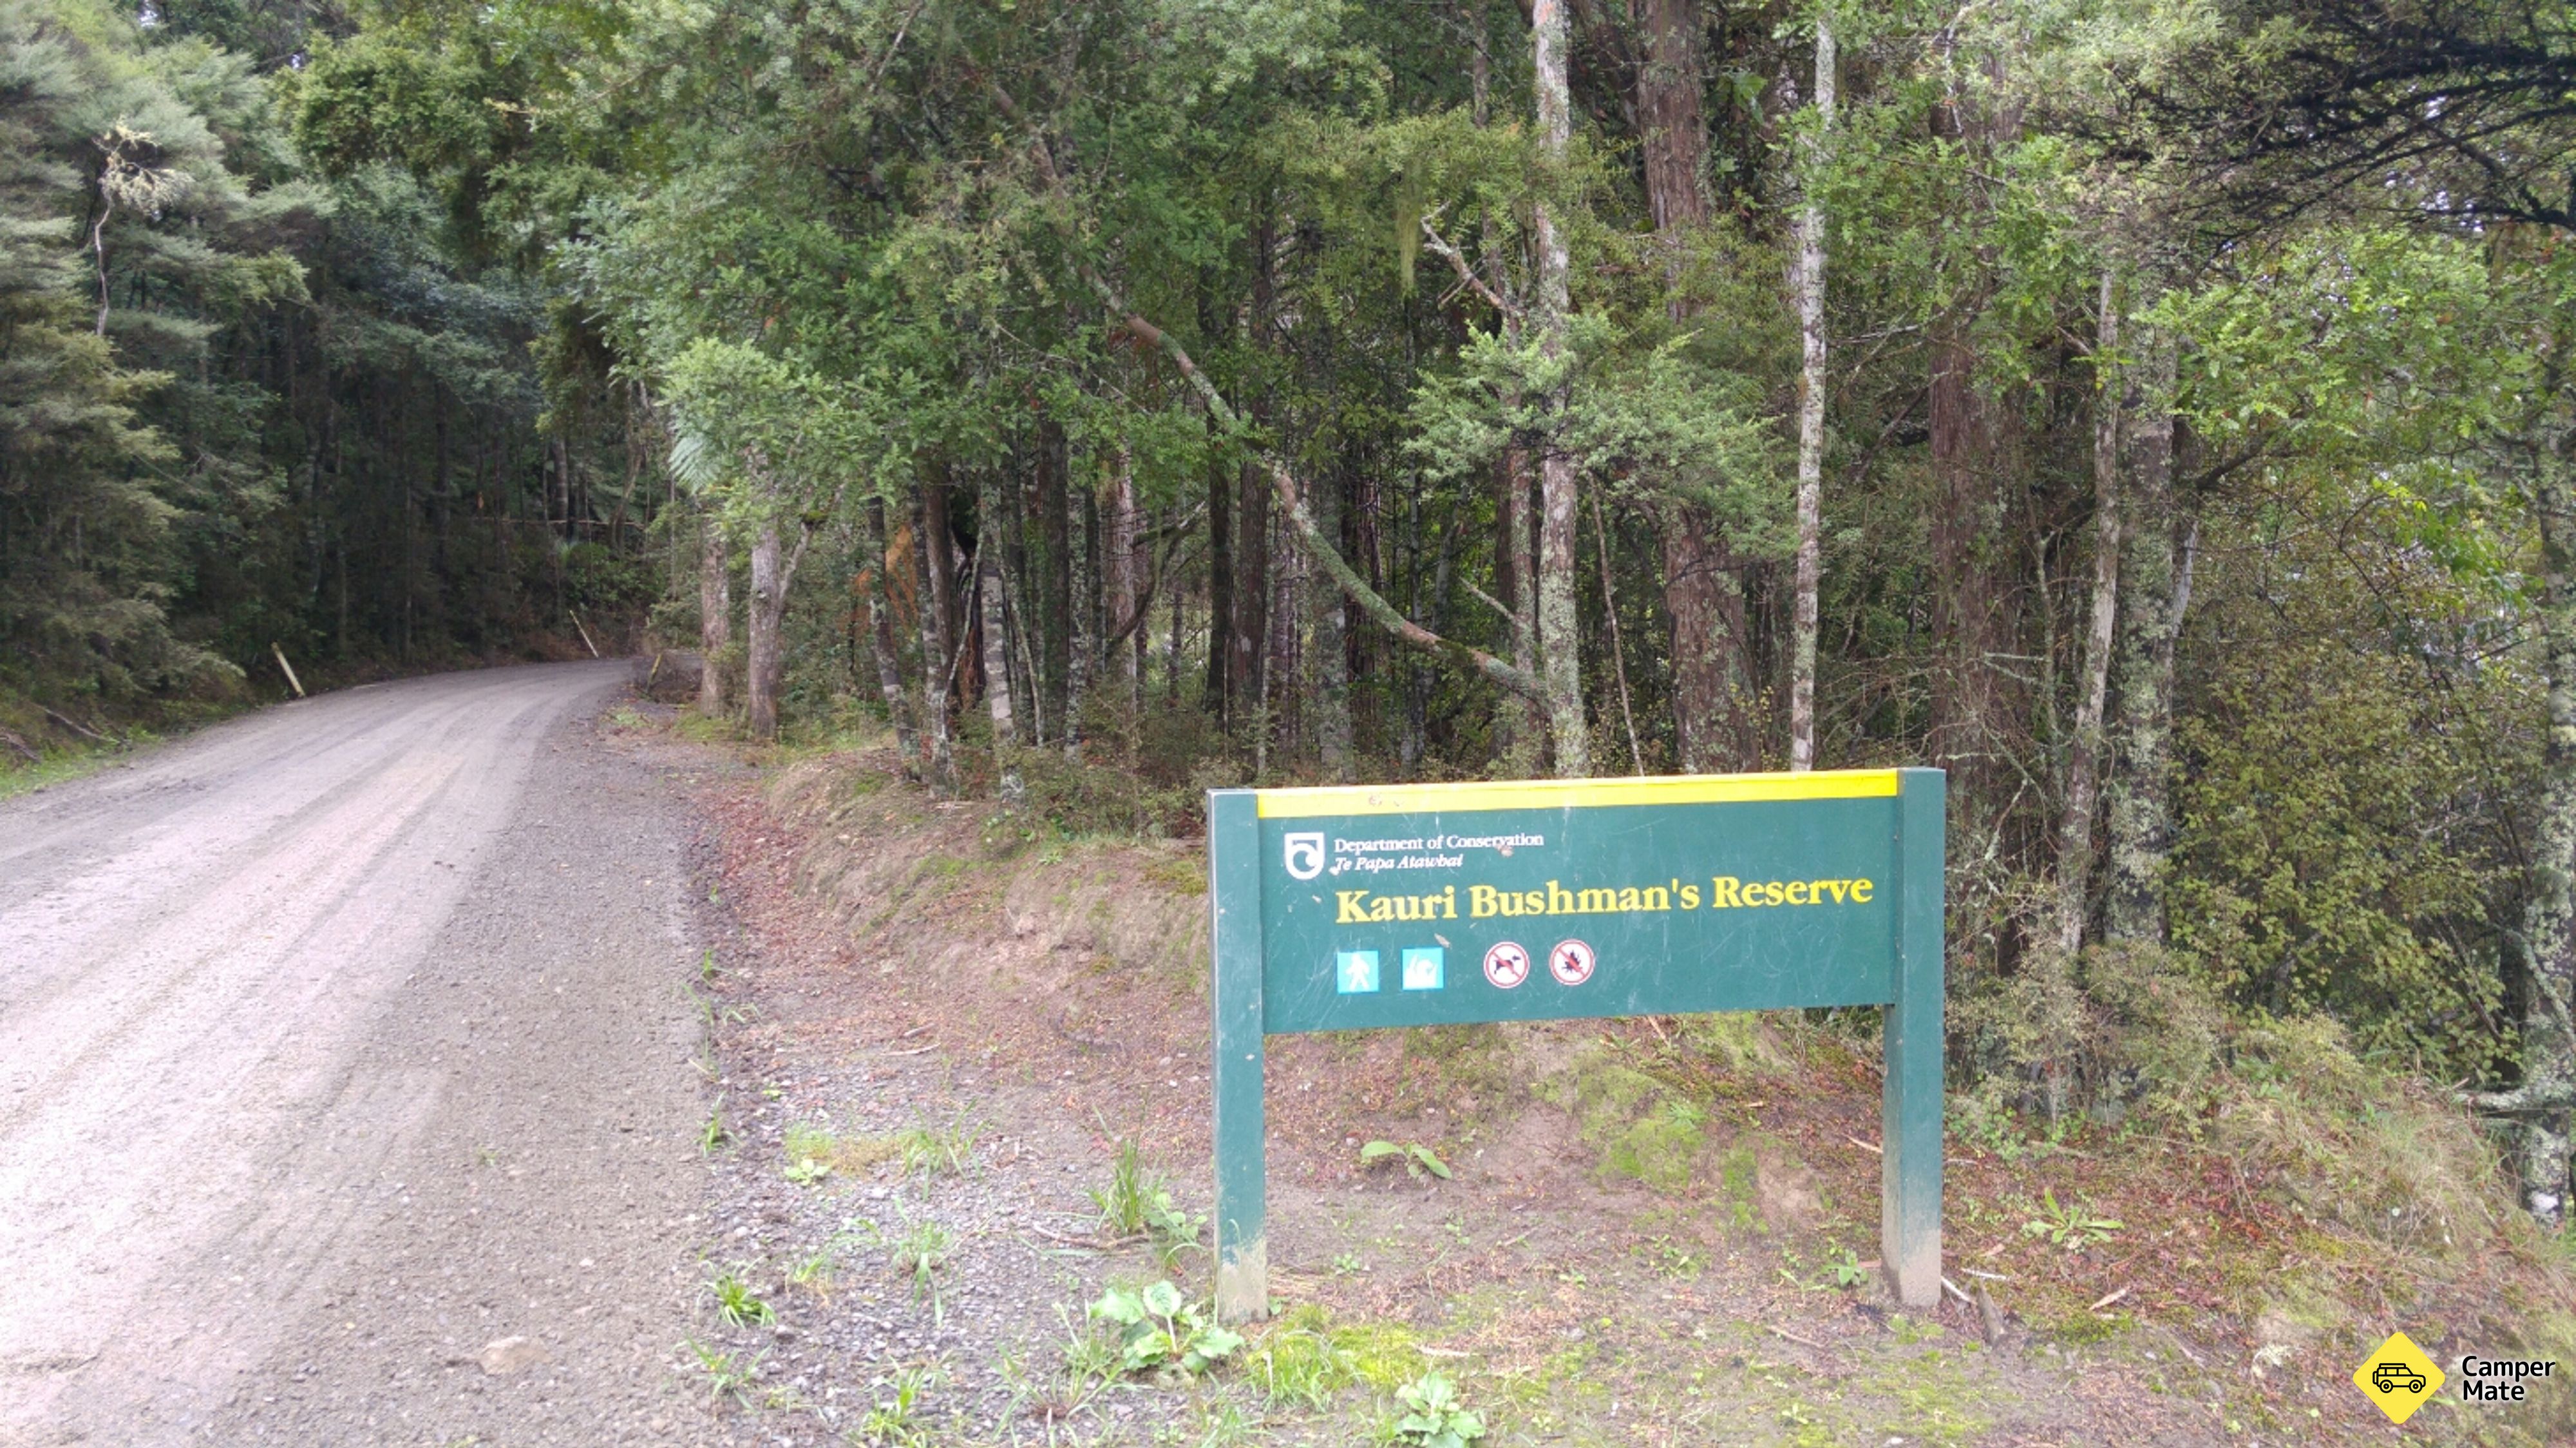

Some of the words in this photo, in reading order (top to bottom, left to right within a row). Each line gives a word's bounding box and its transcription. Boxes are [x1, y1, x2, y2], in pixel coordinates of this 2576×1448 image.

[1334, 838, 1423, 855] Department
[1427, 835, 1444, 850] of
[1446, 832, 1544, 848] Conservation
[1335, 857, 1352, 870] Te
[1355, 857, 1394, 873] Papa
[1335, 885, 1457, 924] Kauri
[1468, 878, 1700, 918] Bushman's
[1712, 876, 1873, 908] Reserve
